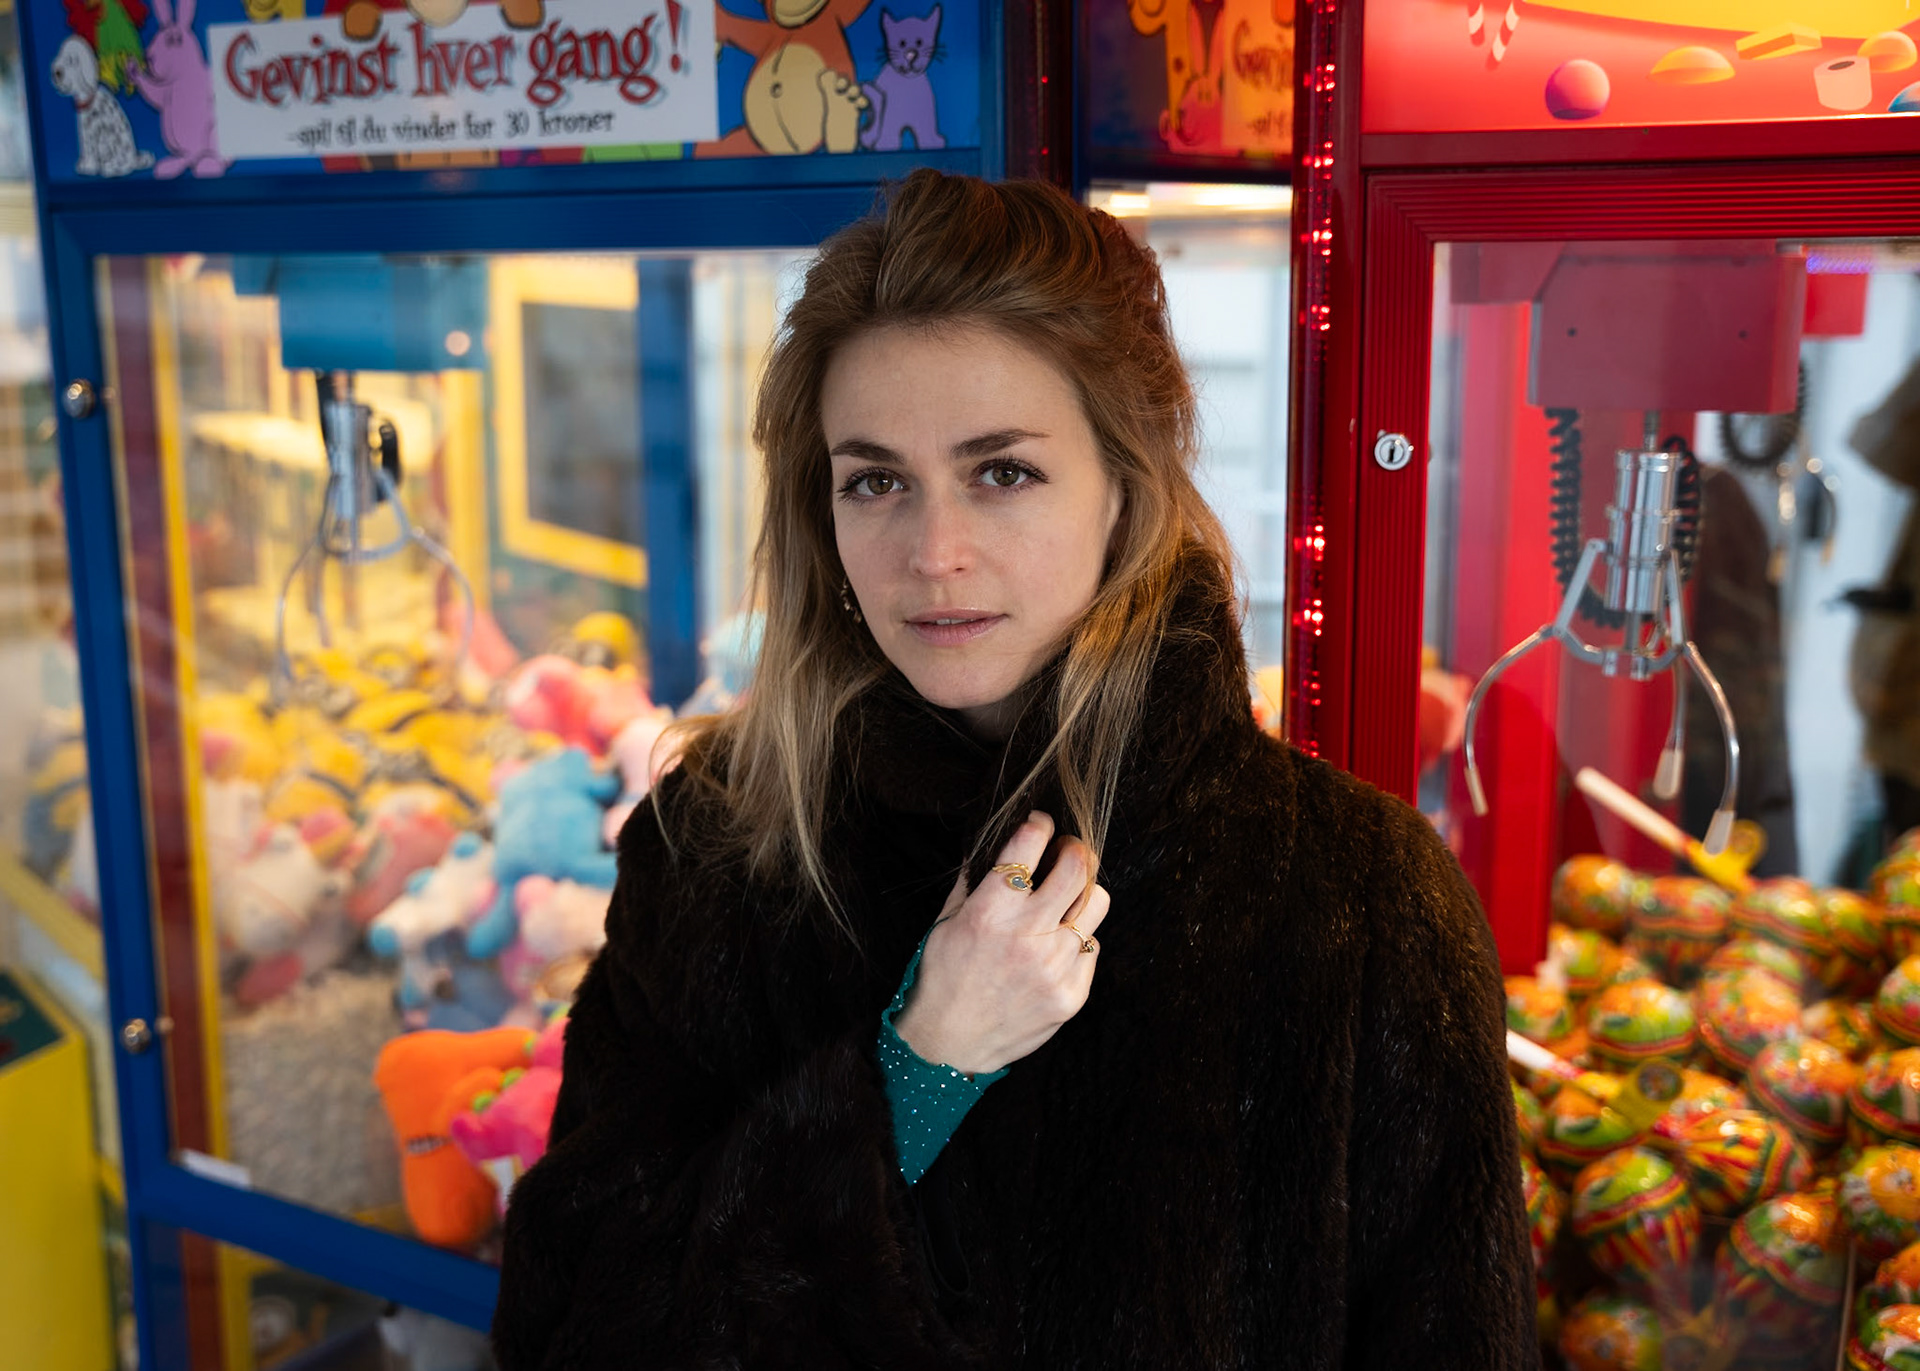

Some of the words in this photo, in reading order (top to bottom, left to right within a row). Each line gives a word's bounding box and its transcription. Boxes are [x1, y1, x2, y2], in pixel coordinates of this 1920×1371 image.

[224, 30, 400, 107] Gevinst
[405, 20, 516, 96] hver
[362, 114, 387, 143] du
[392, 111, 456, 142] vinder
[504, 107, 530, 138] 30
[537, 107, 616, 137] kroner
